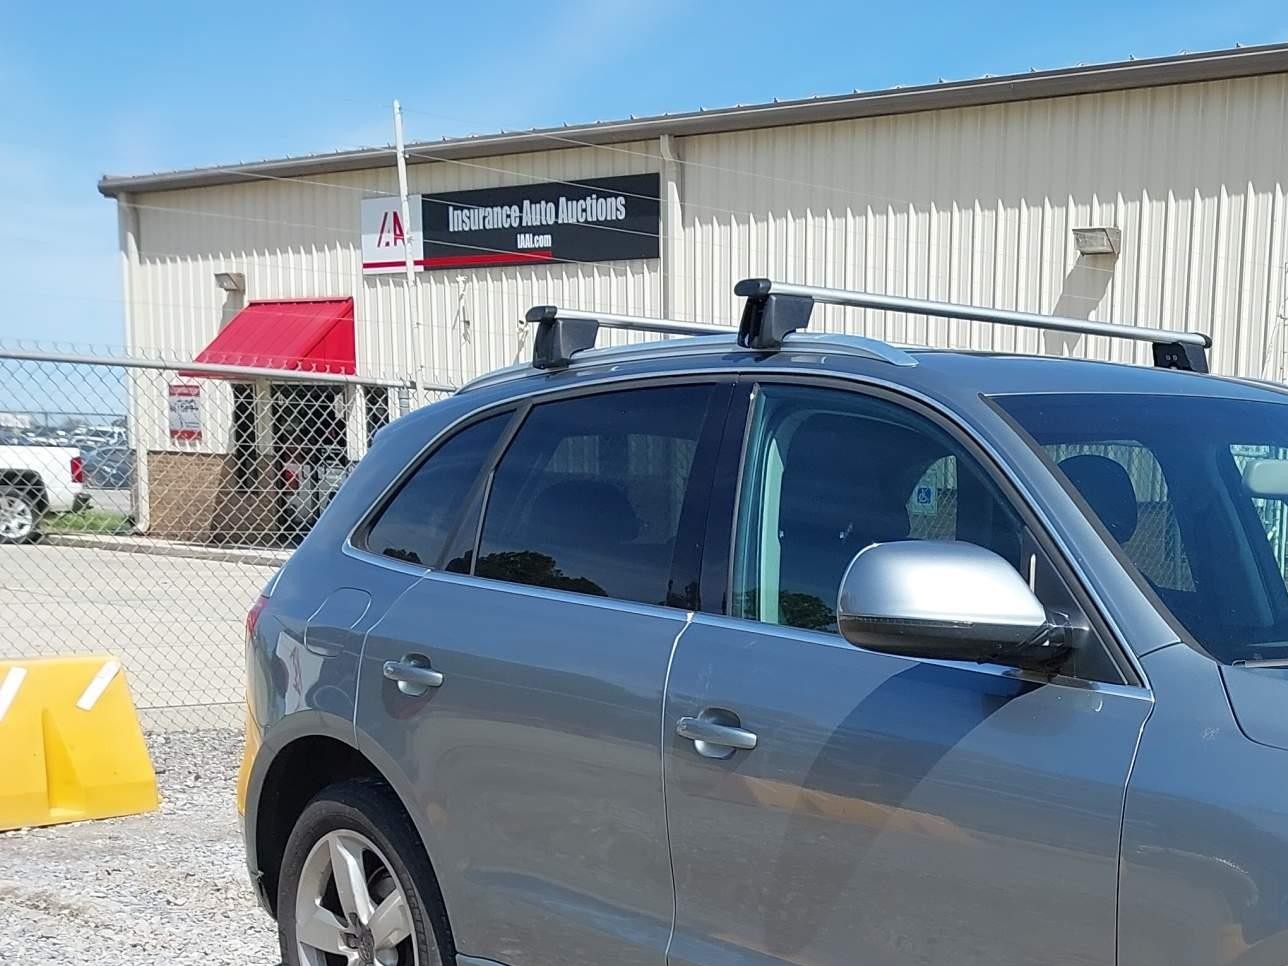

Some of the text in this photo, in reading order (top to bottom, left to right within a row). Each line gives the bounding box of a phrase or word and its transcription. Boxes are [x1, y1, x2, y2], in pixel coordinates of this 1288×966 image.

[449, 194, 626, 232] Insurance Auto Auctions
[517, 233, 552, 249] IAAI.com
